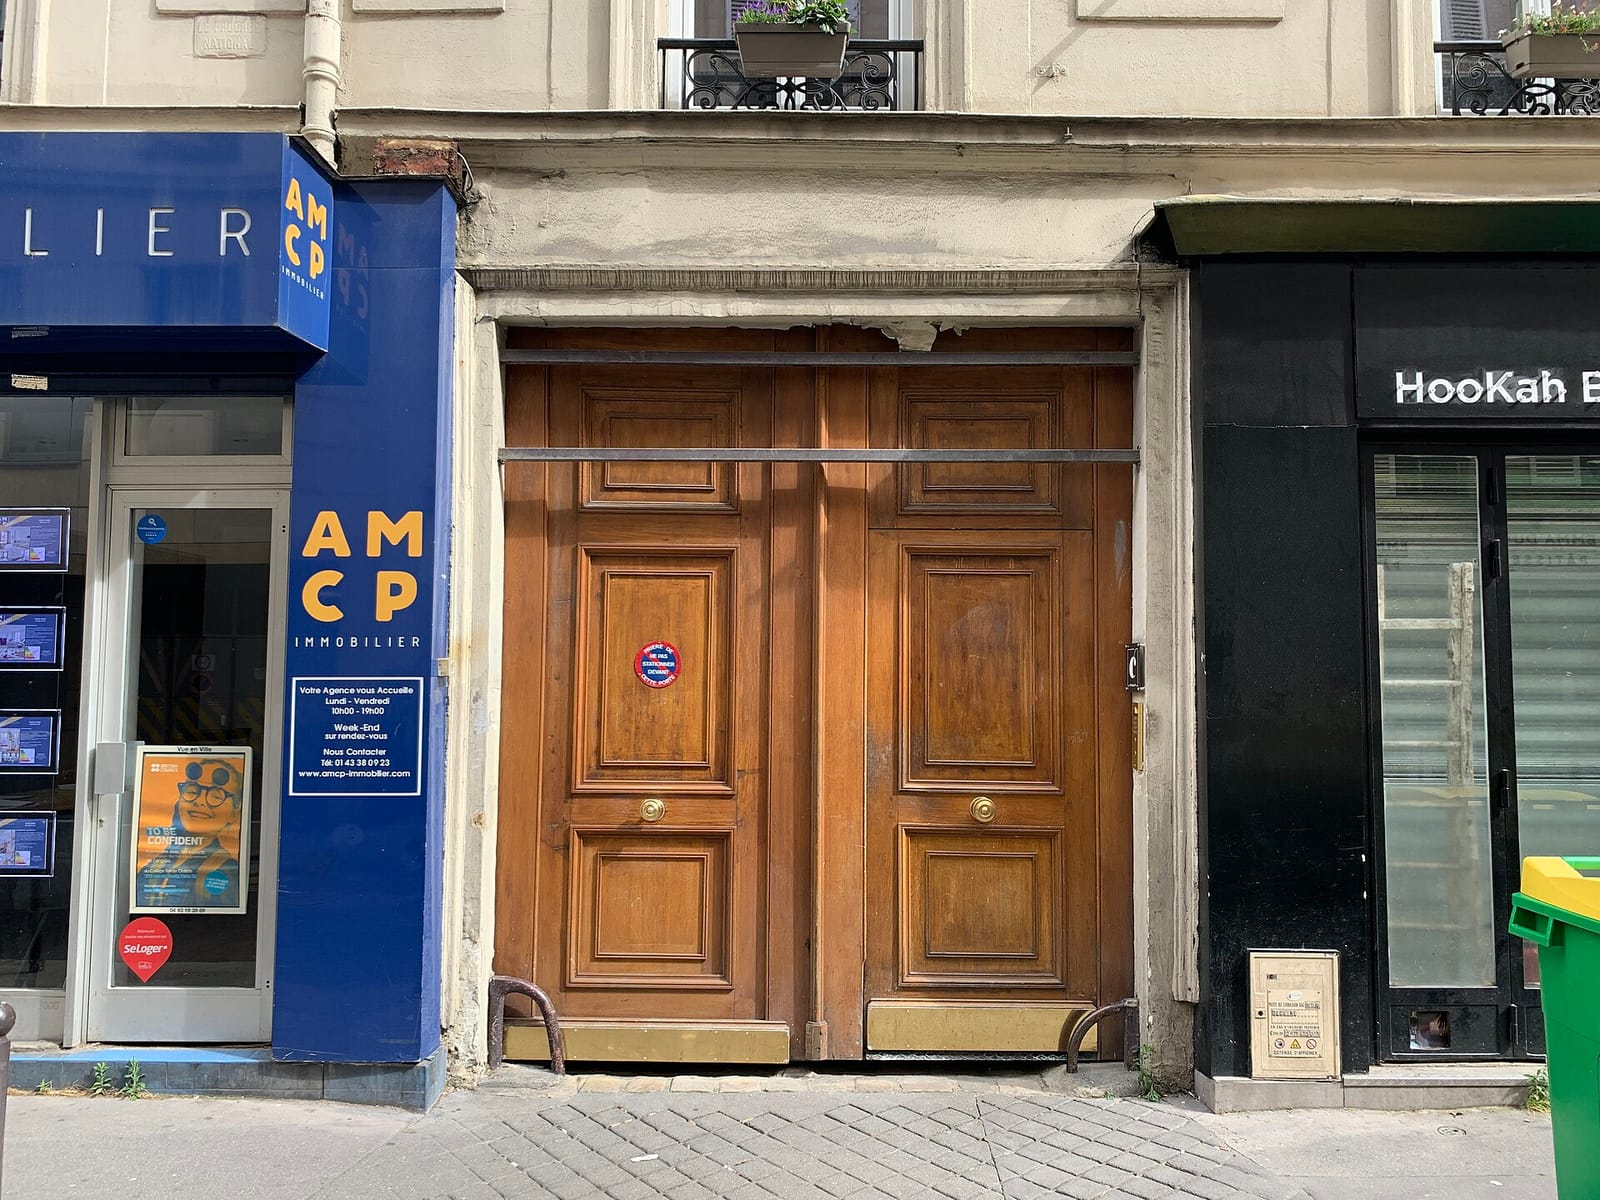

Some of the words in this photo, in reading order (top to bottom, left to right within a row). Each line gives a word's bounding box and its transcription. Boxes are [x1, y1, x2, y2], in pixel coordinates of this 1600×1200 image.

[202, 38, 254, 50] NATIONAL
[24, 207, 251, 256] LIER
[281, 265, 325, 300] IMMOBILIER
[294, 636, 420, 648] IMMOBILIER
[299, 687, 321, 695] Votre
[322, 687, 355, 696] Agence
[377, 686, 414, 695] Accueille
[325, 697, 347, 705] Lundi
[353, 697, 390, 705] Vendredi
[331, 707, 355, 715] 10h00
[361, 707, 385, 715] 19h00
[337, 732, 388, 740] rendez-vous
[323, 748, 345, 756] Nous
[346, 748, 387, 756] Contacter
[334, 759, 344, 767] 01
[344, 759, 355, 767] 43
[356, 759, 367, 767] 38
[367, 759, 379, 767] 09
[380, 759, 391, 767] 23
[298, 769, 411, 779] www.amcp-immobilier.com
[147, 827, 161, 836] TO
[163, 827, 176, 836] BE
[147, 836, 204, 846] CONFIDENT
[123, 944, 163, 956] SeLoger
